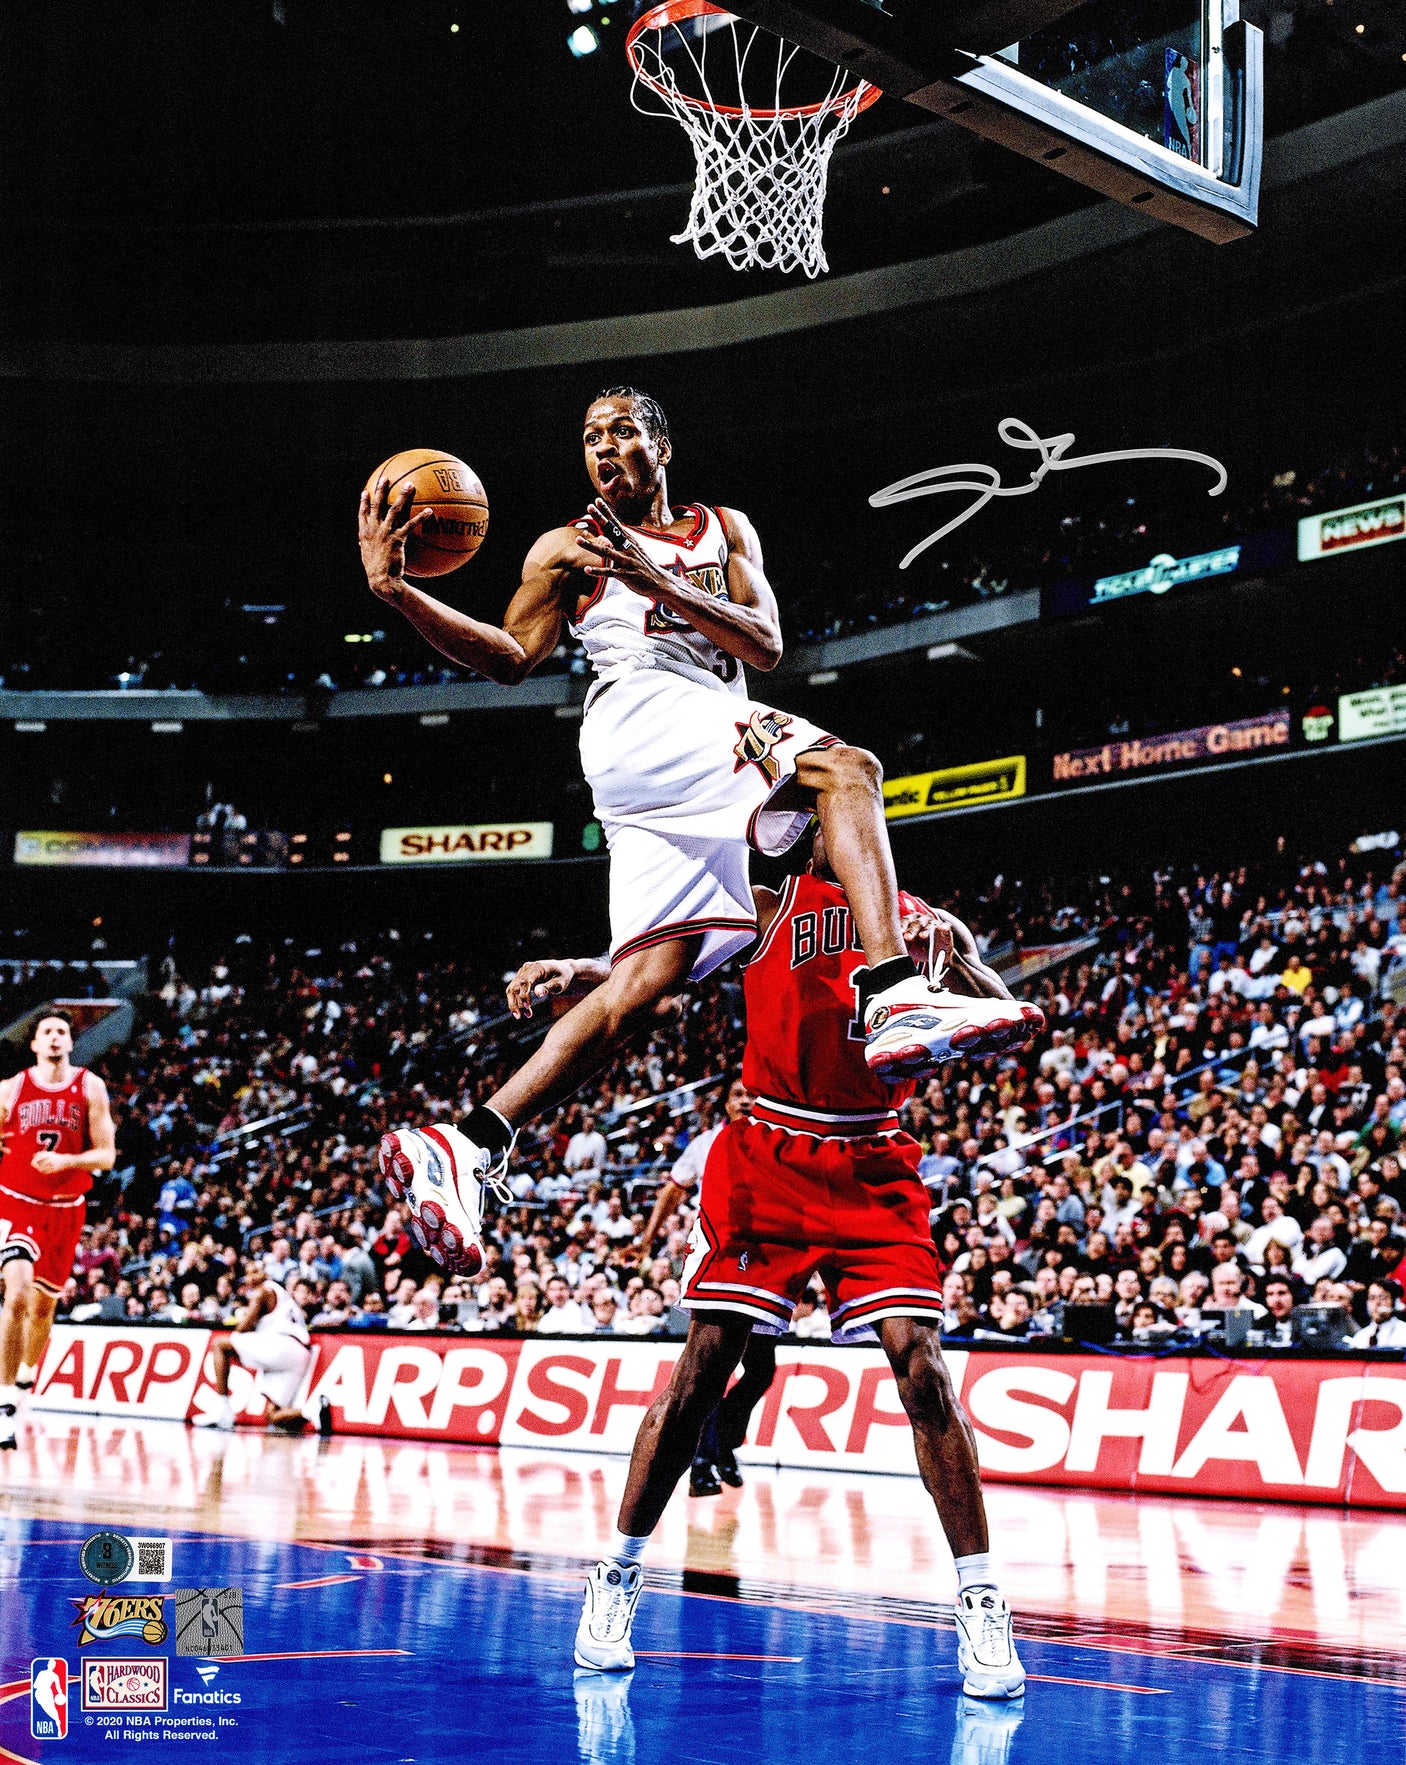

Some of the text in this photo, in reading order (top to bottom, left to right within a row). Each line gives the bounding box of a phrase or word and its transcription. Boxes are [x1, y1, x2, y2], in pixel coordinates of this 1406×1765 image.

[1053, 747, 1113, 782] Next
[1119, 738, 1197, 771] Home
[1206, 723, 1290, 755] Game
[400, 830, 532, 857] SHARP
[18, 1098, 82, 1135] BULLS
[32, 1339, 191, 1404] ARP
